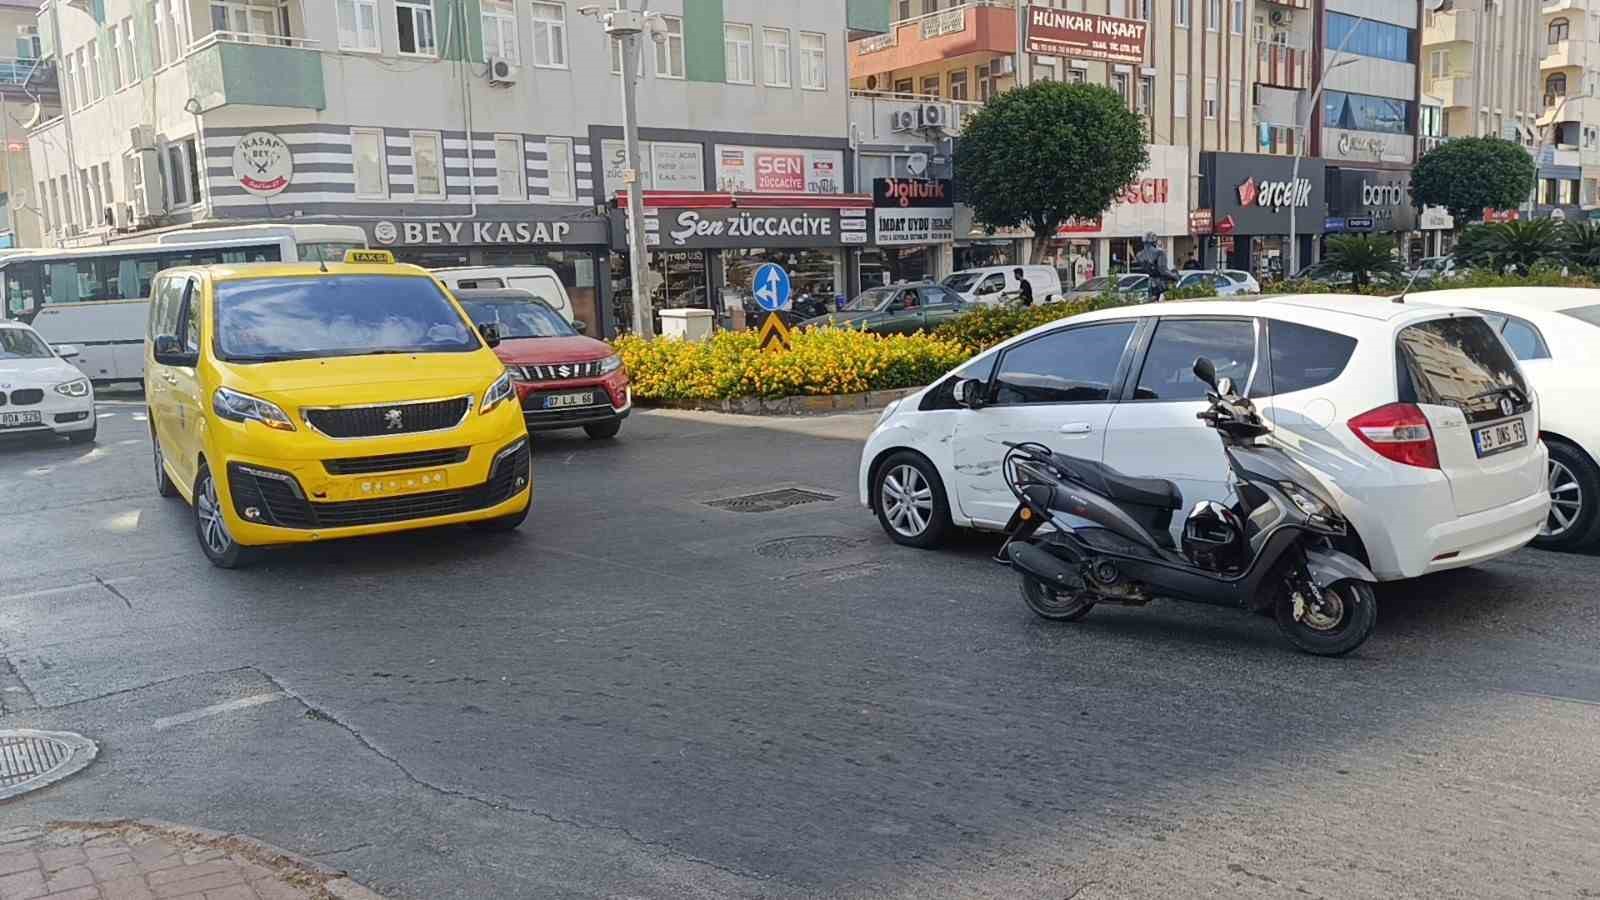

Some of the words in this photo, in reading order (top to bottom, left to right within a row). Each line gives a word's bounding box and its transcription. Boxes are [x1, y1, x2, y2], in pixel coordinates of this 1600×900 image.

[1033, 9, 1092, 33] HÜNKAR
[1096, 16, 1144, 39] İNŞAAT
[240, 137, 280, 150] KASAP
[1258, 178, 1312, 214] arçelik
[403, 222, 462, 244] BEY
[473, 221, 570, 243] KASAP
[671, 211, 724, 244] Şen
[727, 212, 832, 236] ZÜCCACİYE
[879, 215, 906, 232] İMDAT
[908, 216, 929, 232] UYDU
